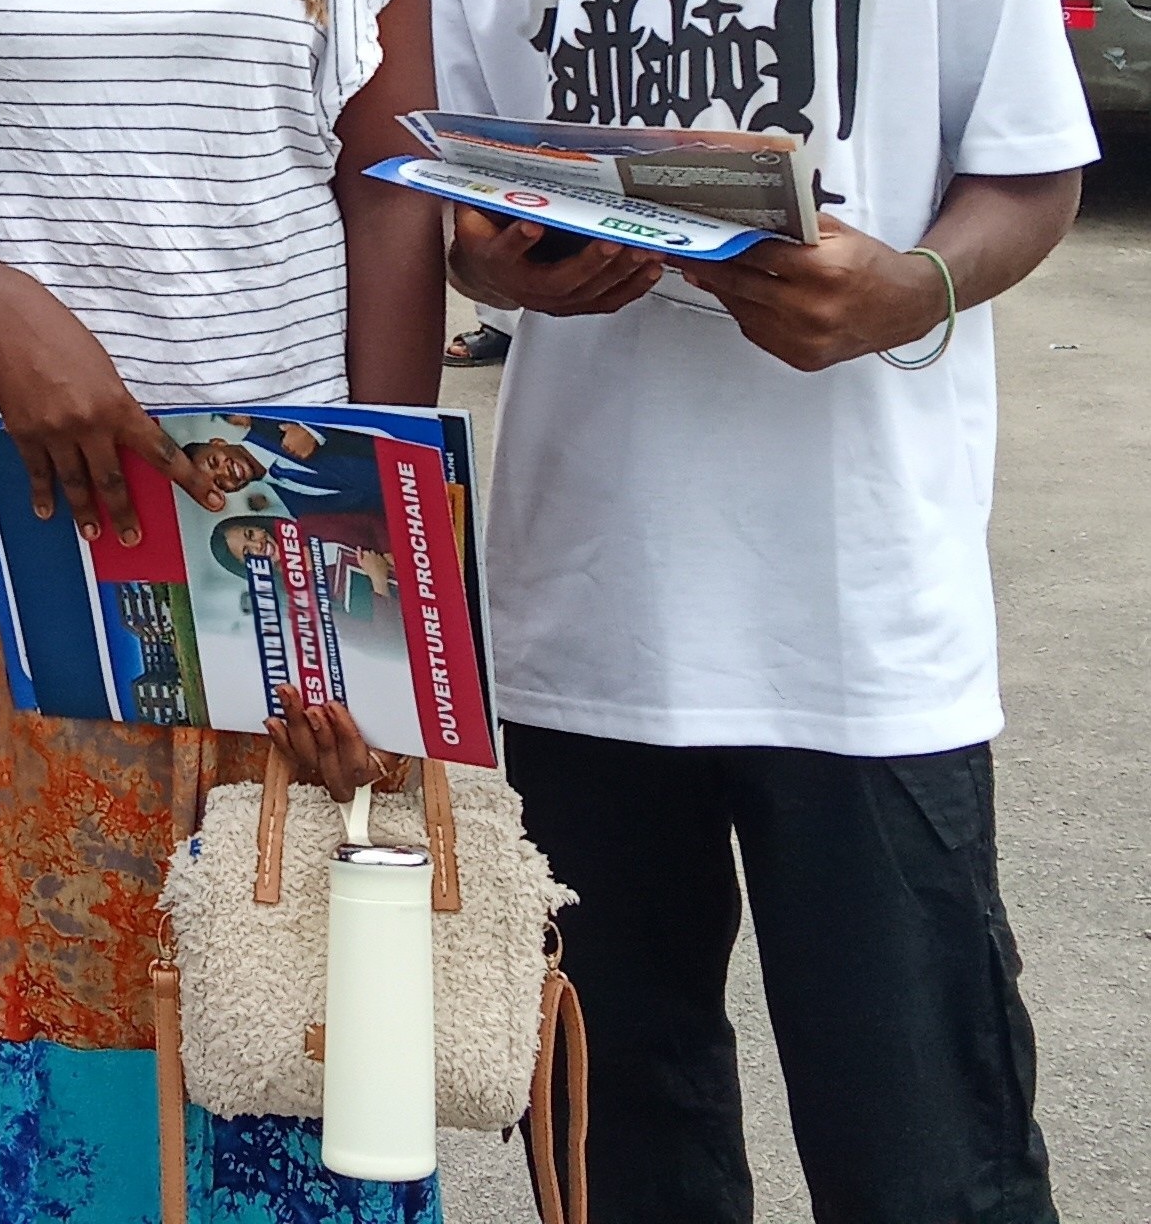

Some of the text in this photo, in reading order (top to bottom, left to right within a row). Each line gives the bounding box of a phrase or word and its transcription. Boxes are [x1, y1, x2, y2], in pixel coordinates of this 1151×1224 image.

[309, 536, 326, 585] IVOIRIEN
[397, 461, 460, 746] OUVERTURE PROCHAINE
[306, 676, 325, 706] ES
